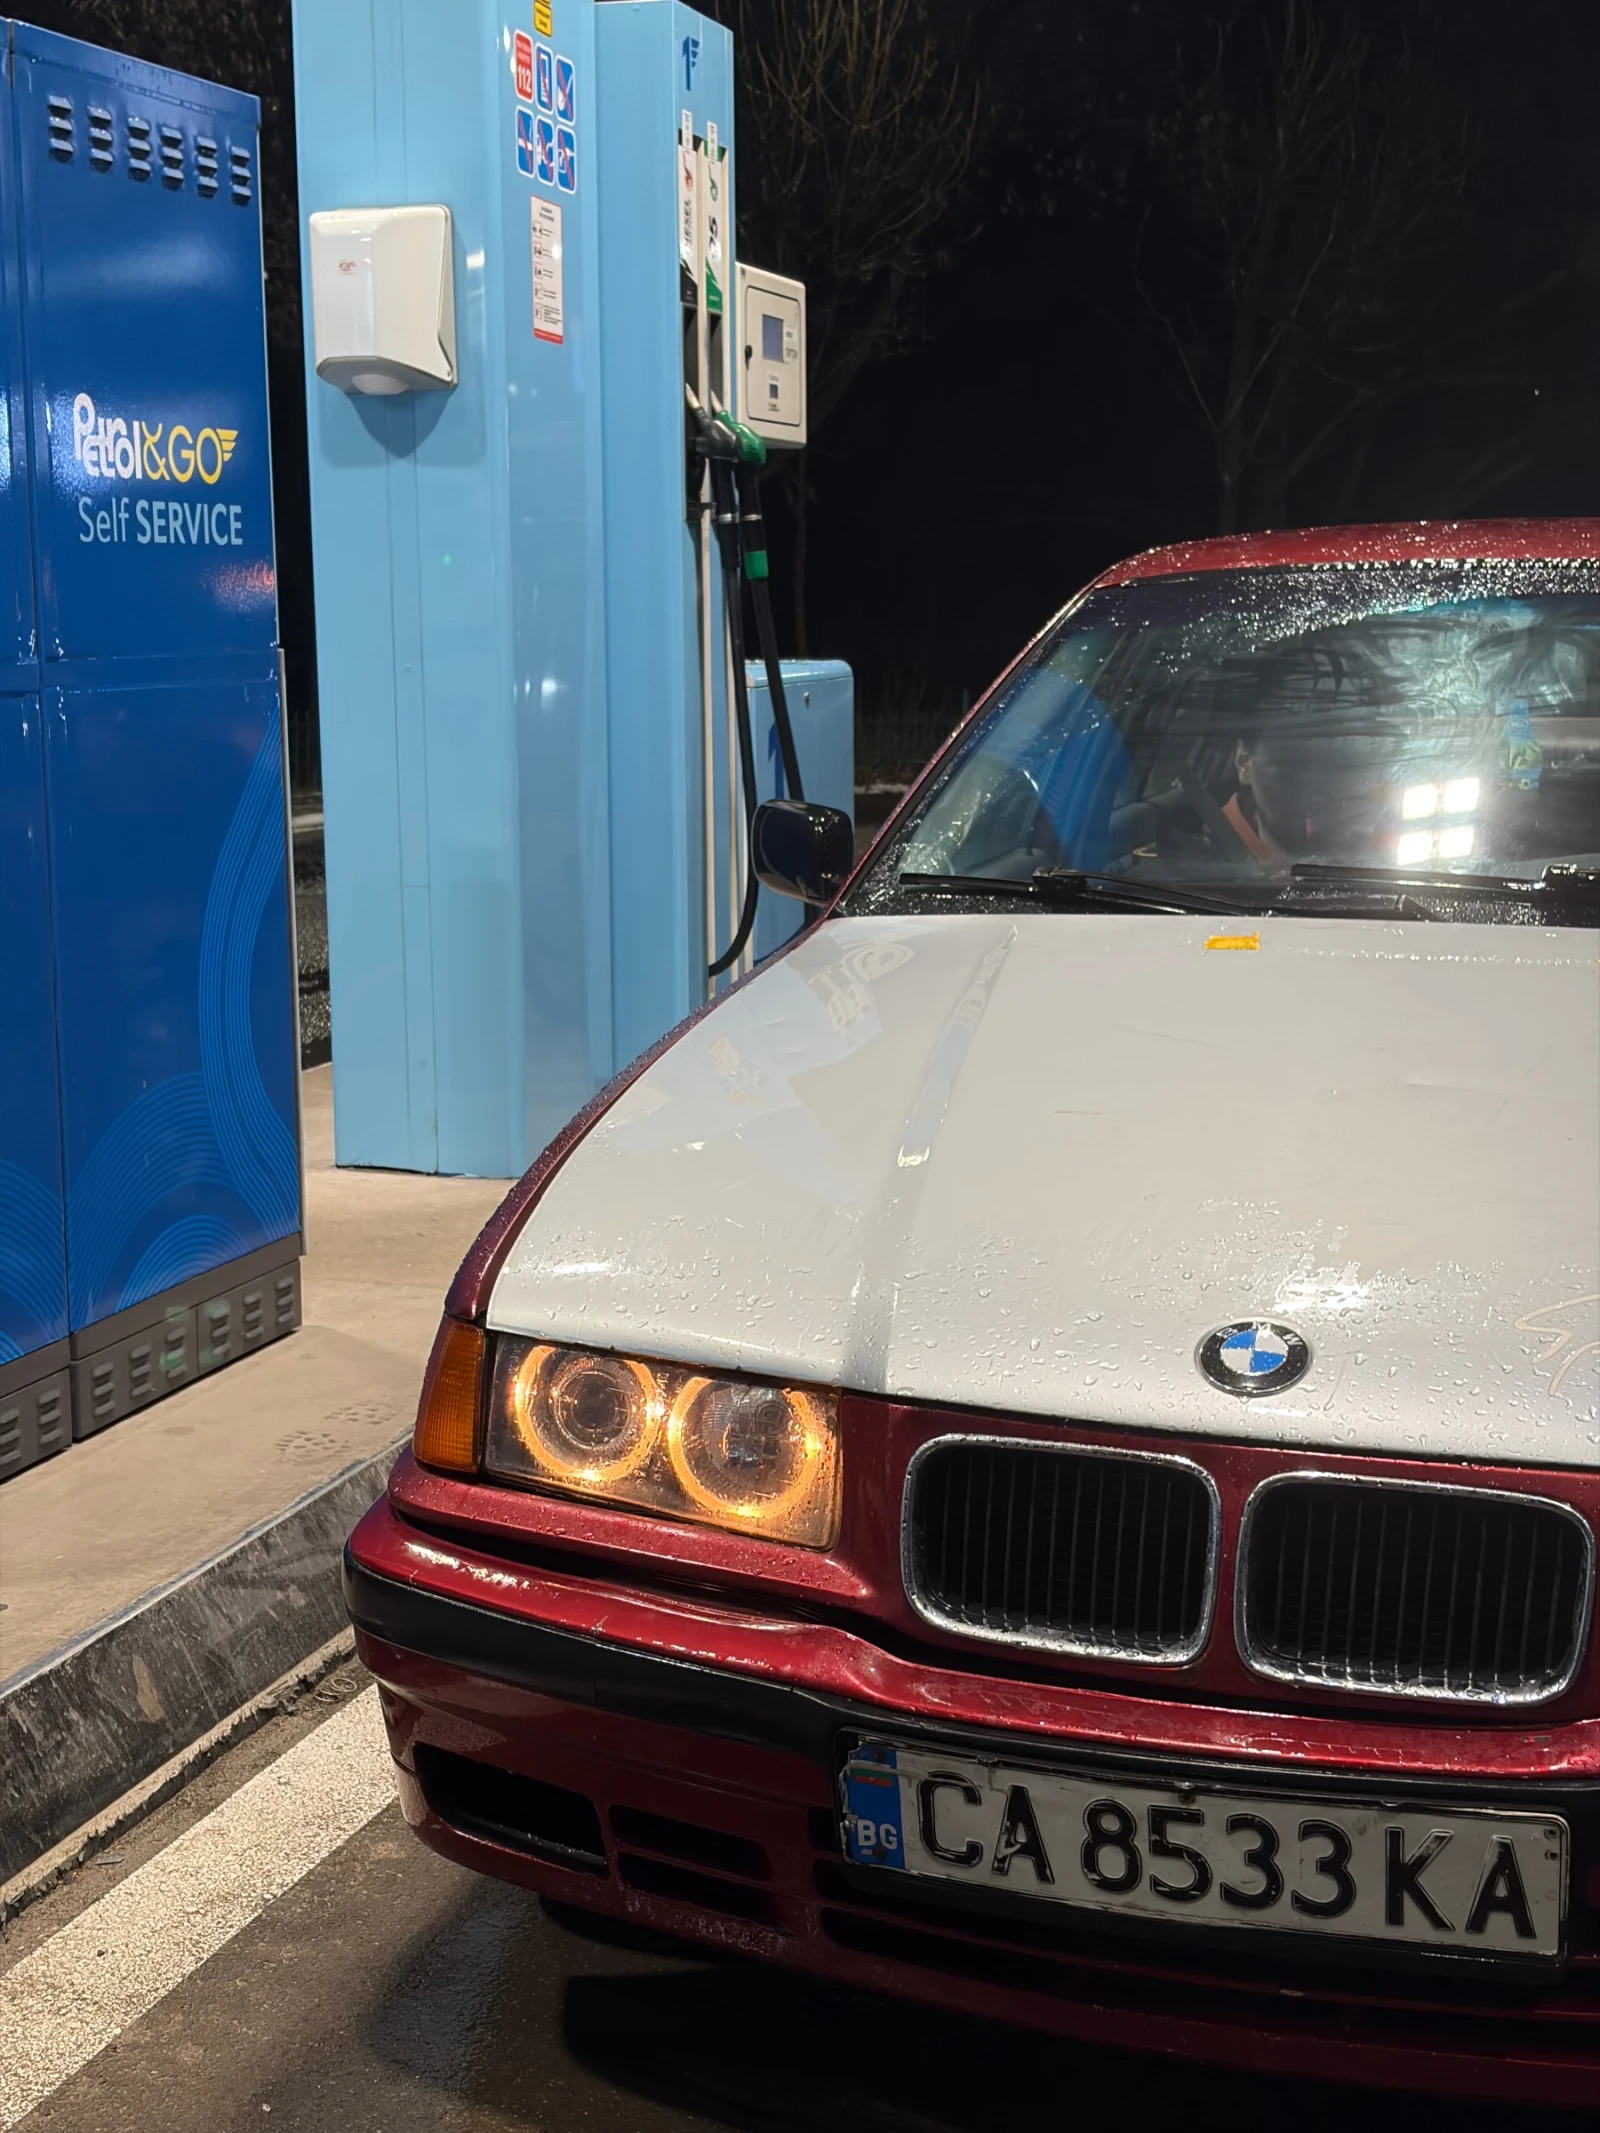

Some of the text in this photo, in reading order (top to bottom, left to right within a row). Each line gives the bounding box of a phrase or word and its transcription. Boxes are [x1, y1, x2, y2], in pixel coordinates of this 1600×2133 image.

[518, 64, 532, 94] 112
[78, 496, 243, 546] Self SERVICE
[1216, 1321, 1303, 1346] BMW
[856, 1819, 898, 1850] BG
[916, 1770, 1537, 1939] CA 8533 KA
